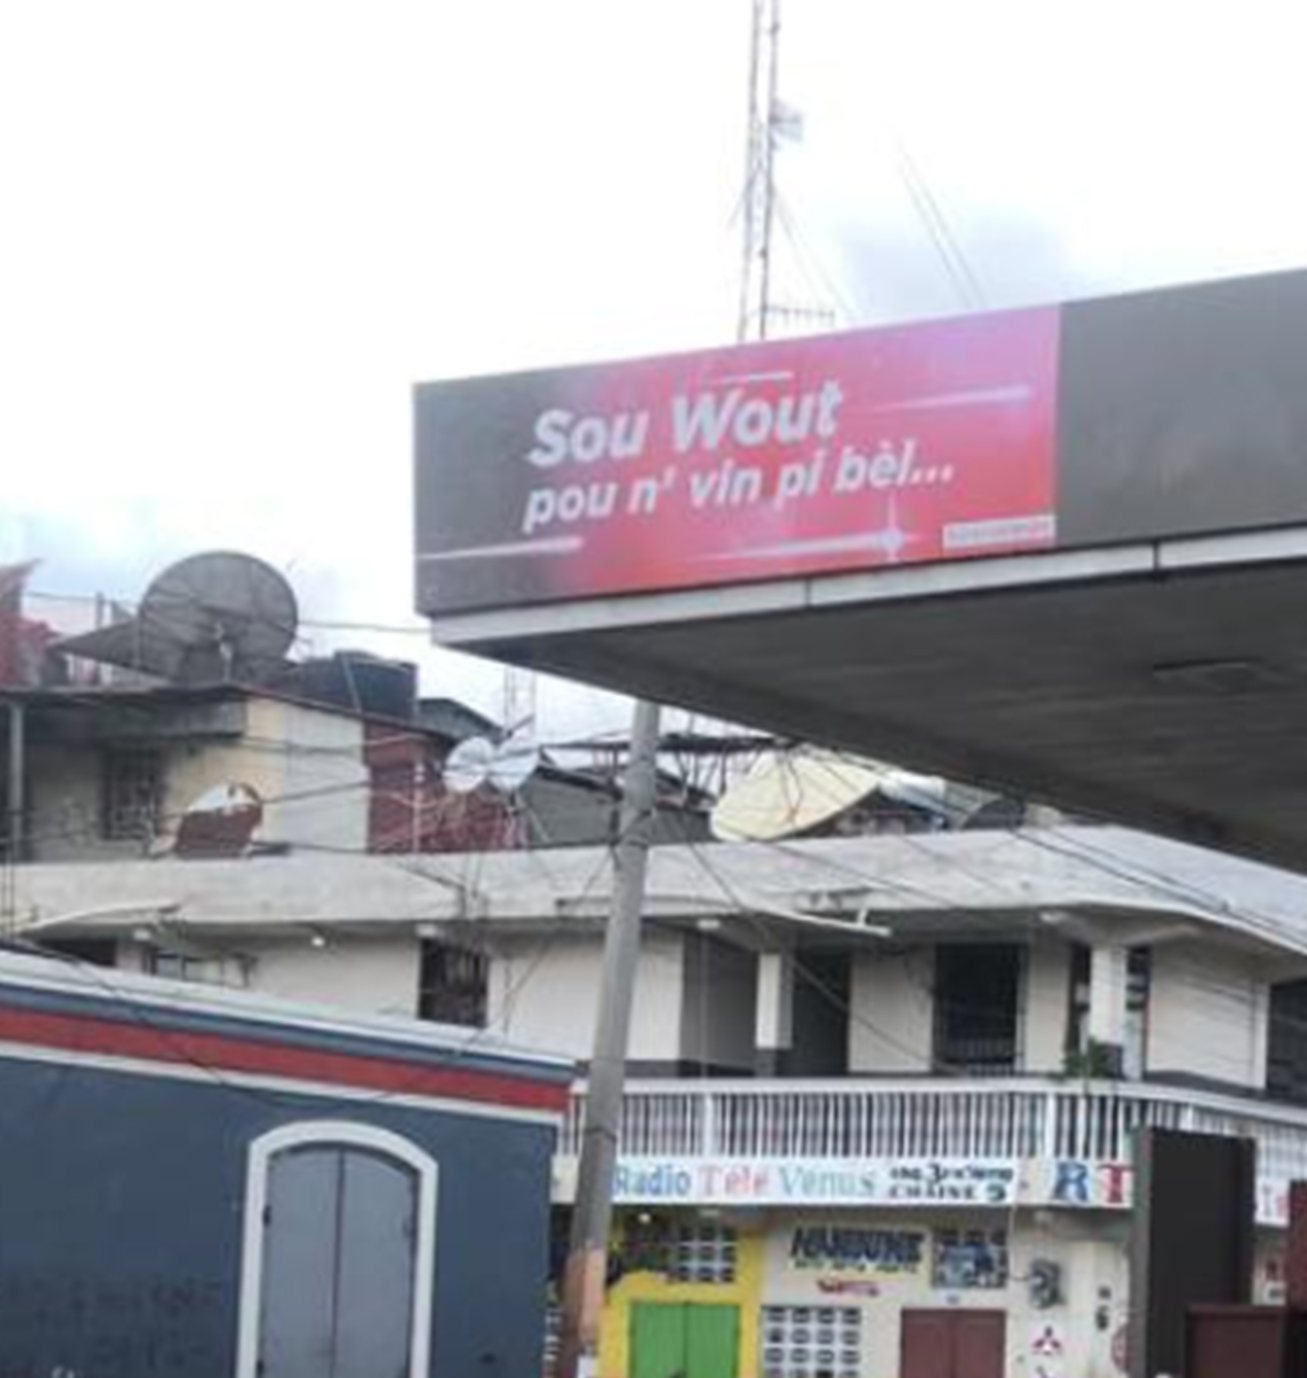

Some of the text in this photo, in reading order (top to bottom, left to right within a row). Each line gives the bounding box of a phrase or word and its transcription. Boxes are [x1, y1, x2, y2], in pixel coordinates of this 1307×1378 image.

[528, 380, 842, 467] Sou Wout
[523, 482, 615, 533] pou
[691, 459, 762, 506] vin
[775, 447, 825, 506] pi
[836, 439, 953, 493] bèl...
[612, 1163, 691, 1198] Radio
